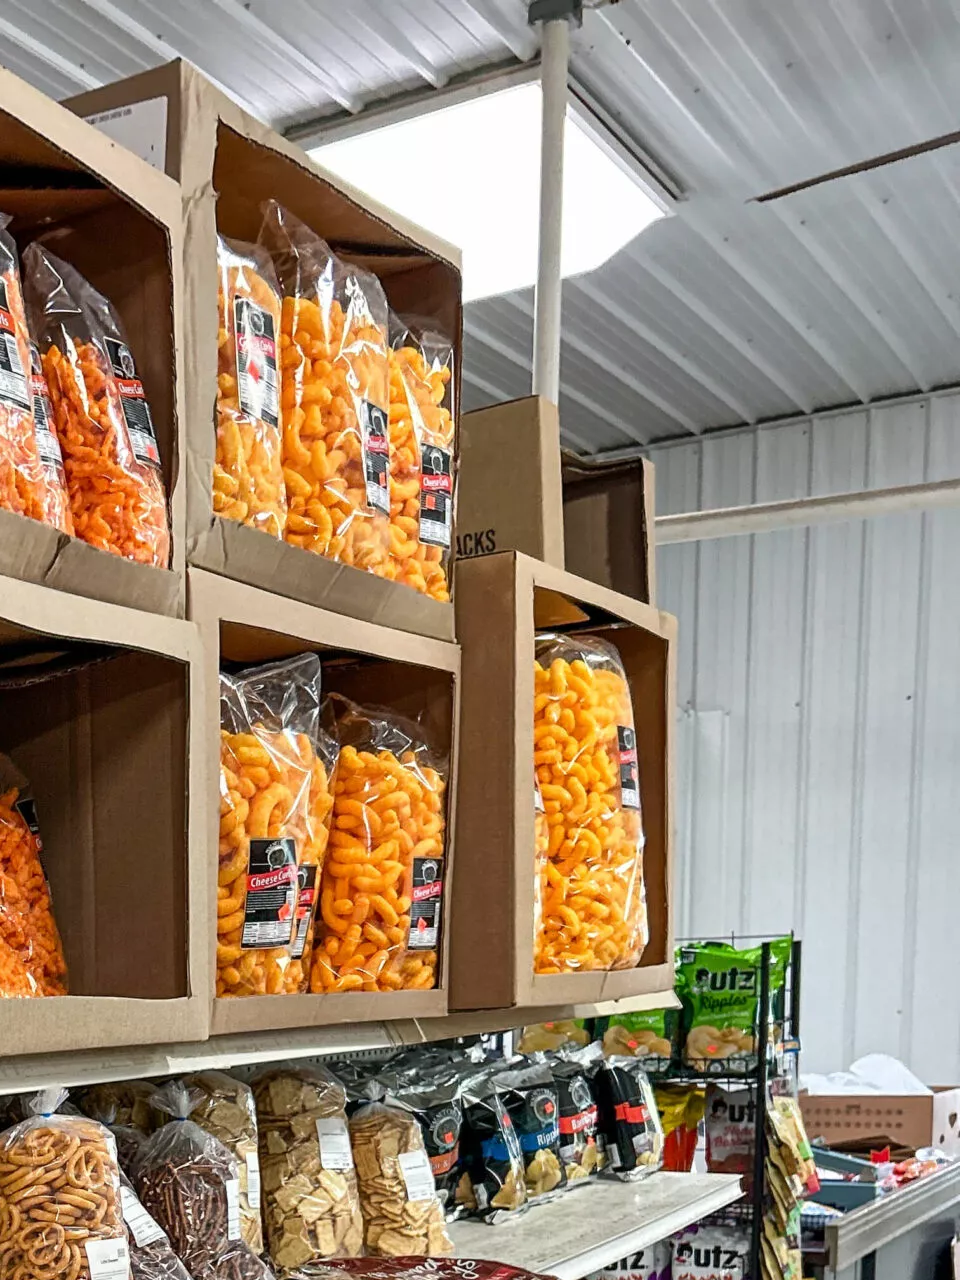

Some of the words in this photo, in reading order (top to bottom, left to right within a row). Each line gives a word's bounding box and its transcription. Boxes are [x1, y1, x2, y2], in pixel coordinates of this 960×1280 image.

[250, 874, 278, 888] Cheese
[710, 966, 755, 991] utz
[693, 1245, 738, 1269] utz
